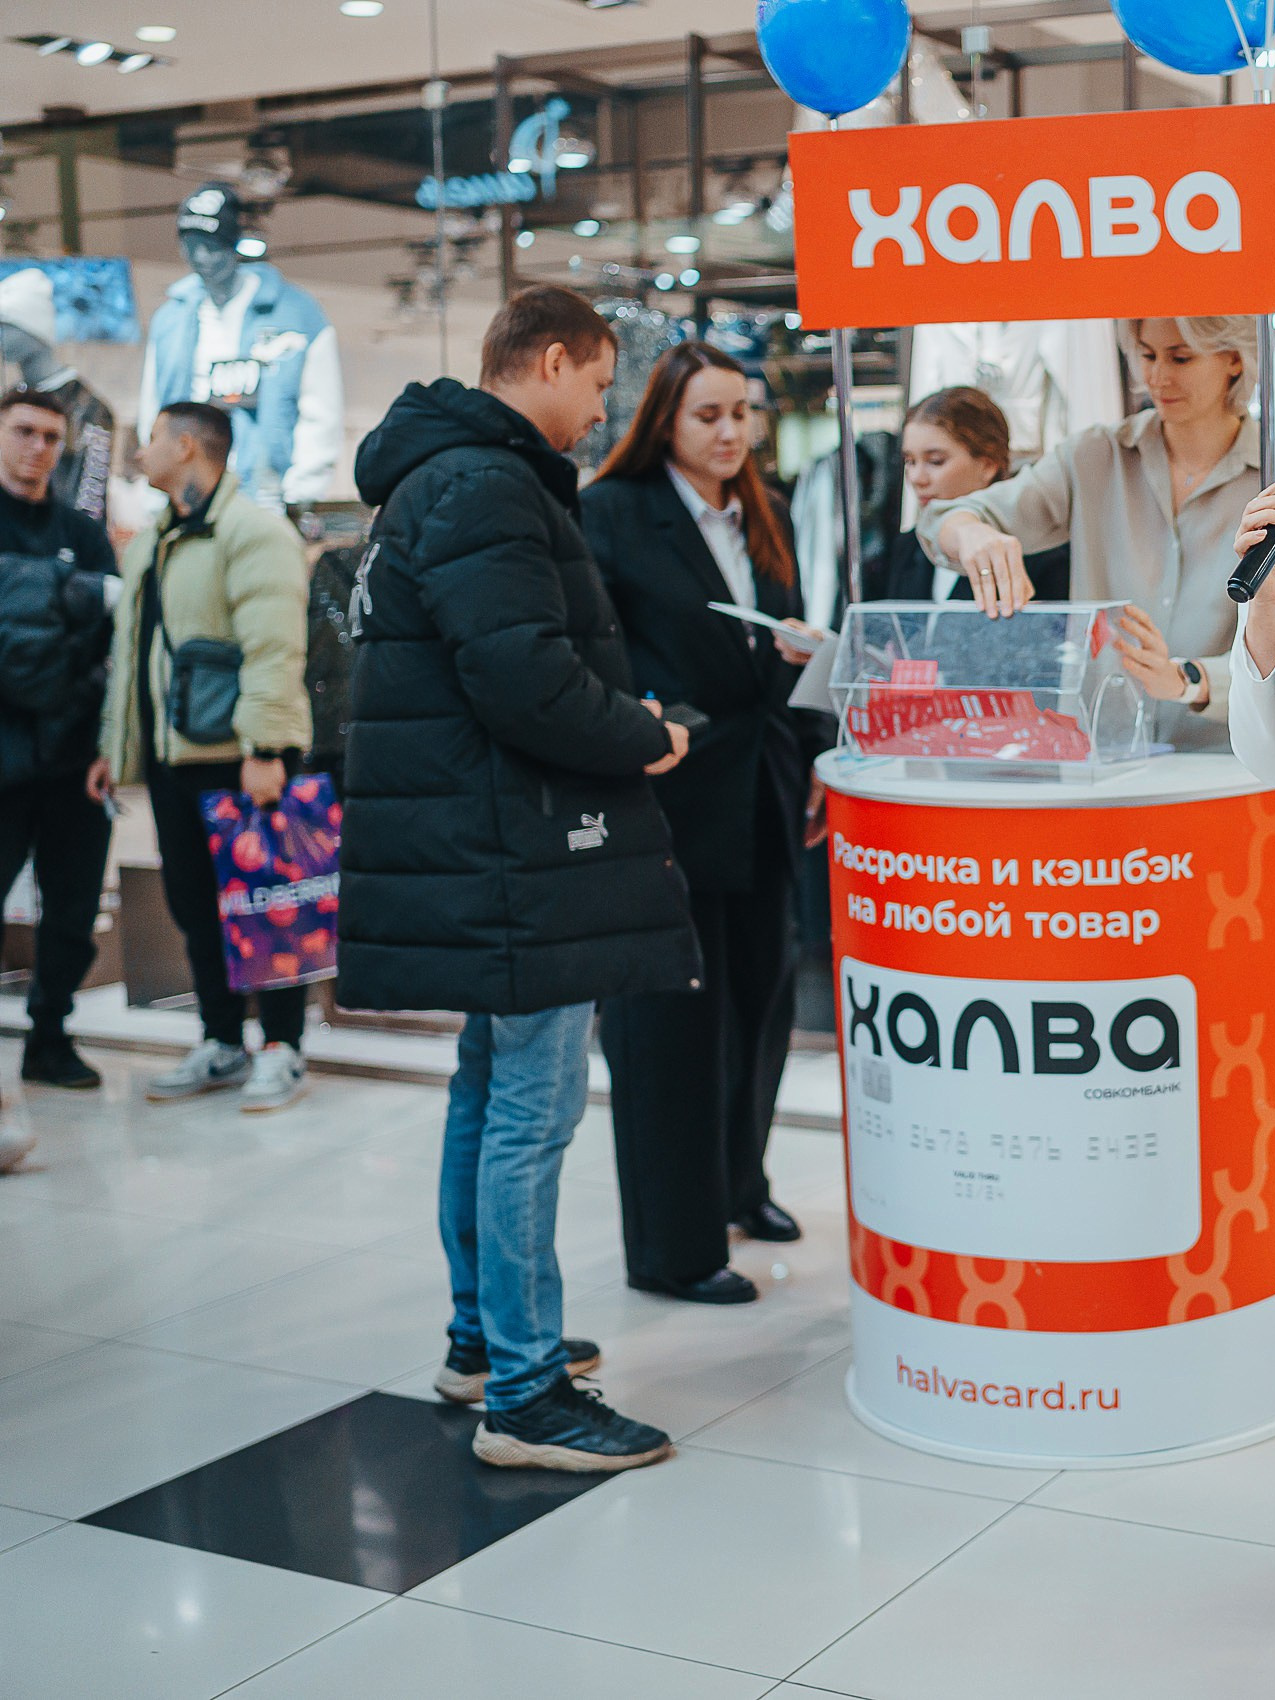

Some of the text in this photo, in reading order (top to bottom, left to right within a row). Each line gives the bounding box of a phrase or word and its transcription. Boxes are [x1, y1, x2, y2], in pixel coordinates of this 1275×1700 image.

[833, 831, 1195, 887] Рассрочка и кэшбэк
[847, 892, 1161, 945] на любой товар
[896, 1354, 1122, 1412] halvacard.ru
